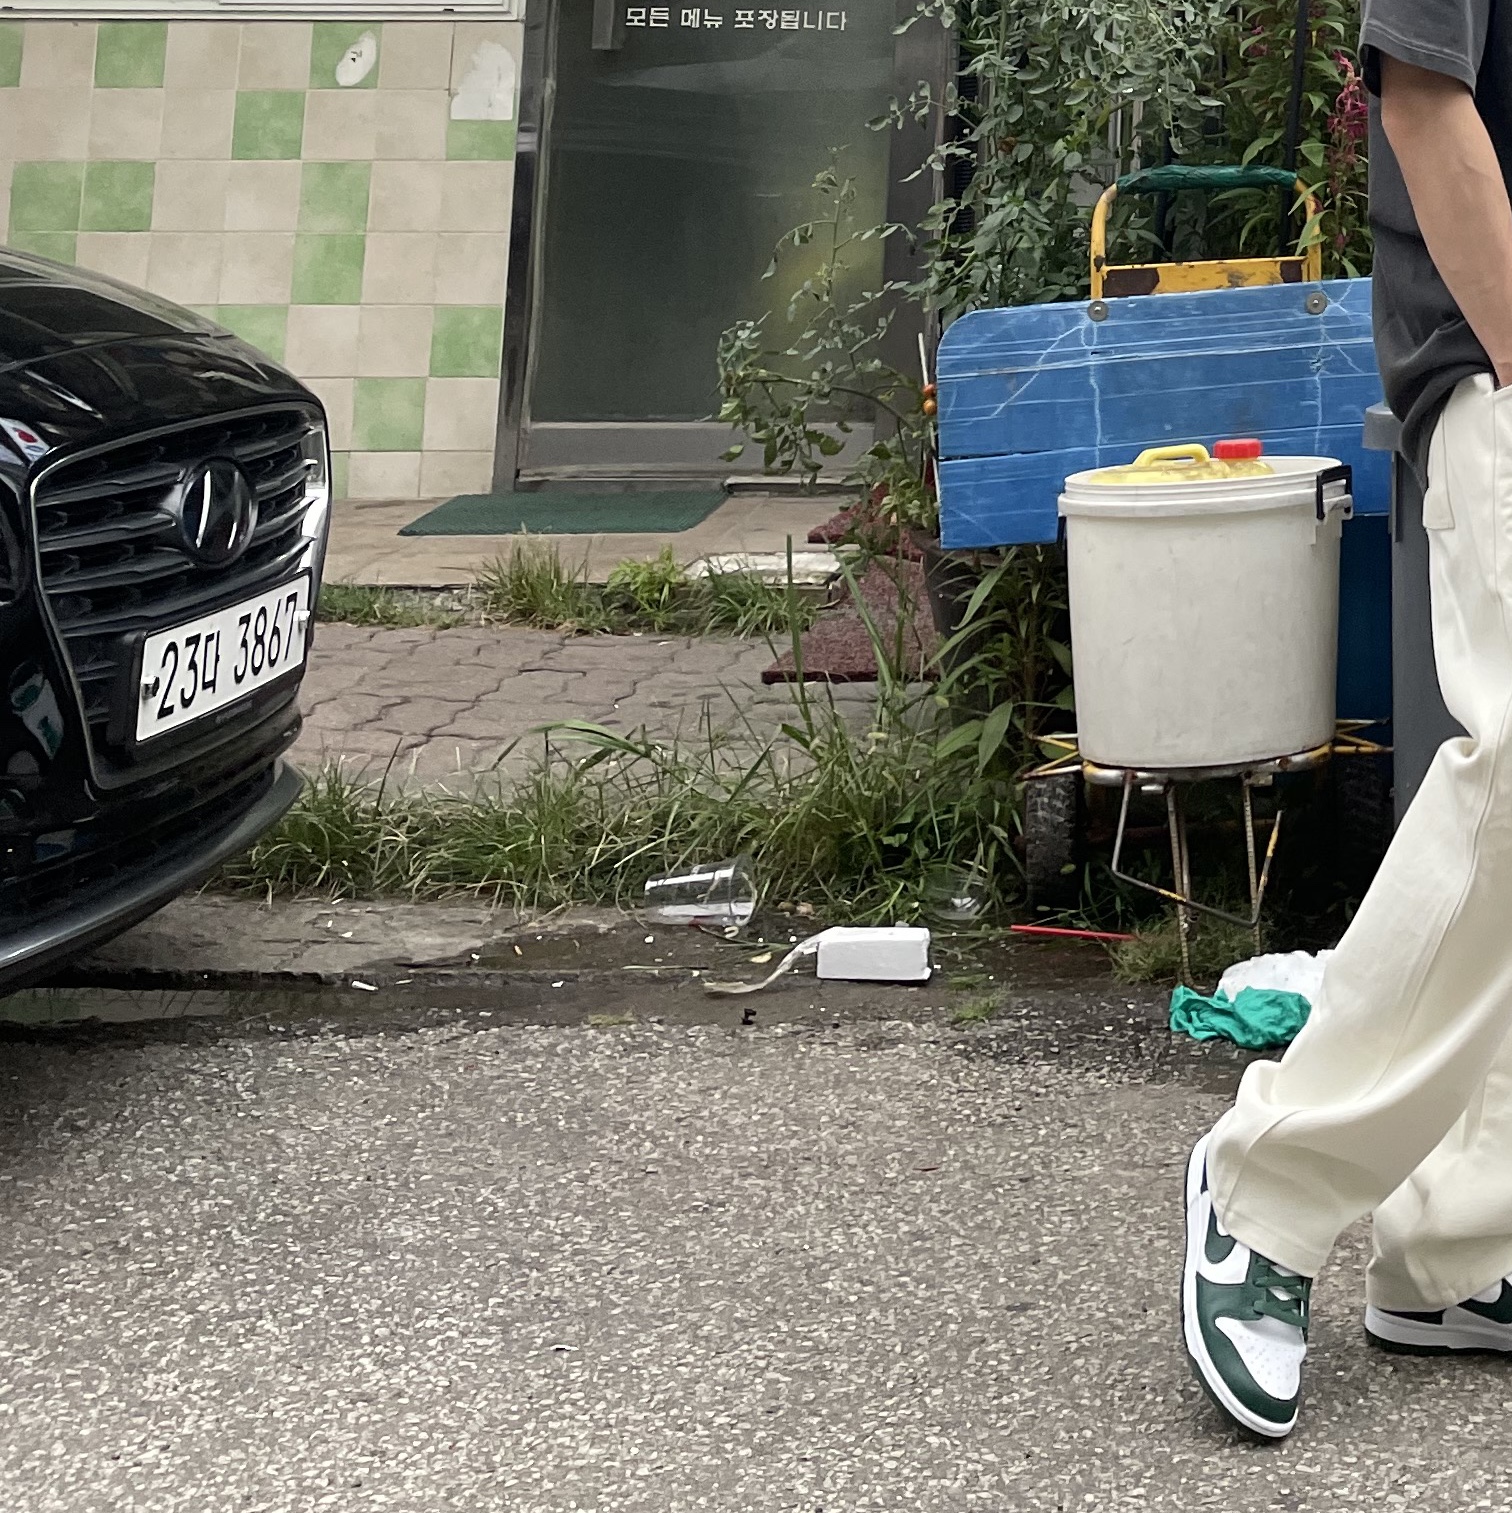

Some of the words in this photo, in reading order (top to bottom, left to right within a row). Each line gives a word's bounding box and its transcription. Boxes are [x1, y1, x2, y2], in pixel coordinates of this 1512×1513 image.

[625, 7, 670, 28] 모든
[680, 8, 723, 29] 메뉴
[734, 9, 847, 31] 포장됩니다
[233, 592, 299, 684] 3867
